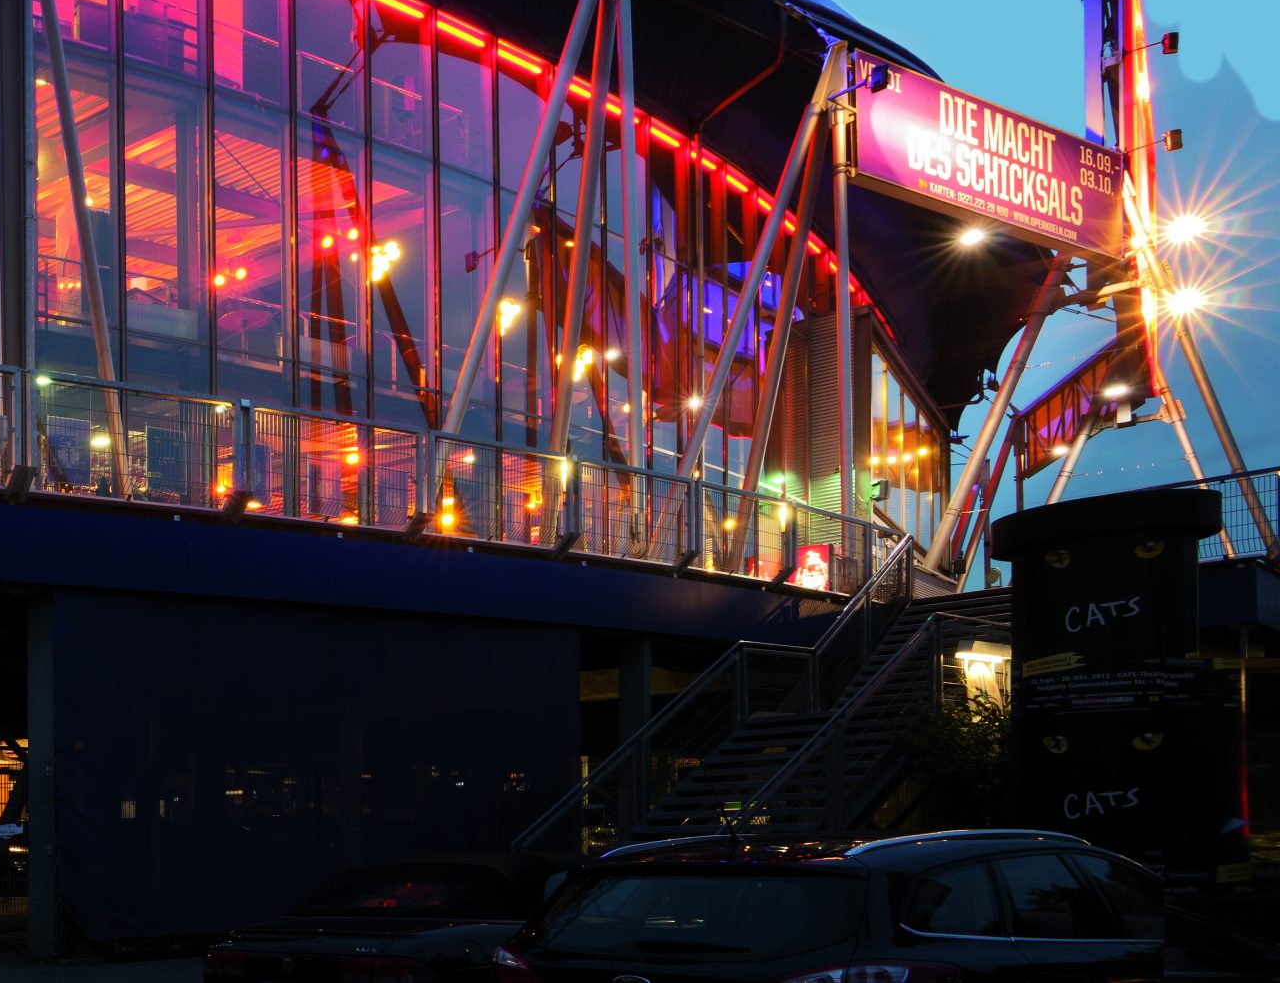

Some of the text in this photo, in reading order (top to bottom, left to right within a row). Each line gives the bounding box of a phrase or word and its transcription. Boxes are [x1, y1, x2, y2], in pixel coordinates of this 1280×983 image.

[859, 59, 902, 93] VEDI
[939, 90, 1056, 173] DIE MACHT
[907, 124, 1083, 226] DES SCHICKSALS
[929, 181, 957, 200] KARTEN:
[1080, 167, 1115, 196] 03.10.
[1065, 596, 1141, 632] CATS
[1063, 787, 1139, 819] CATS
